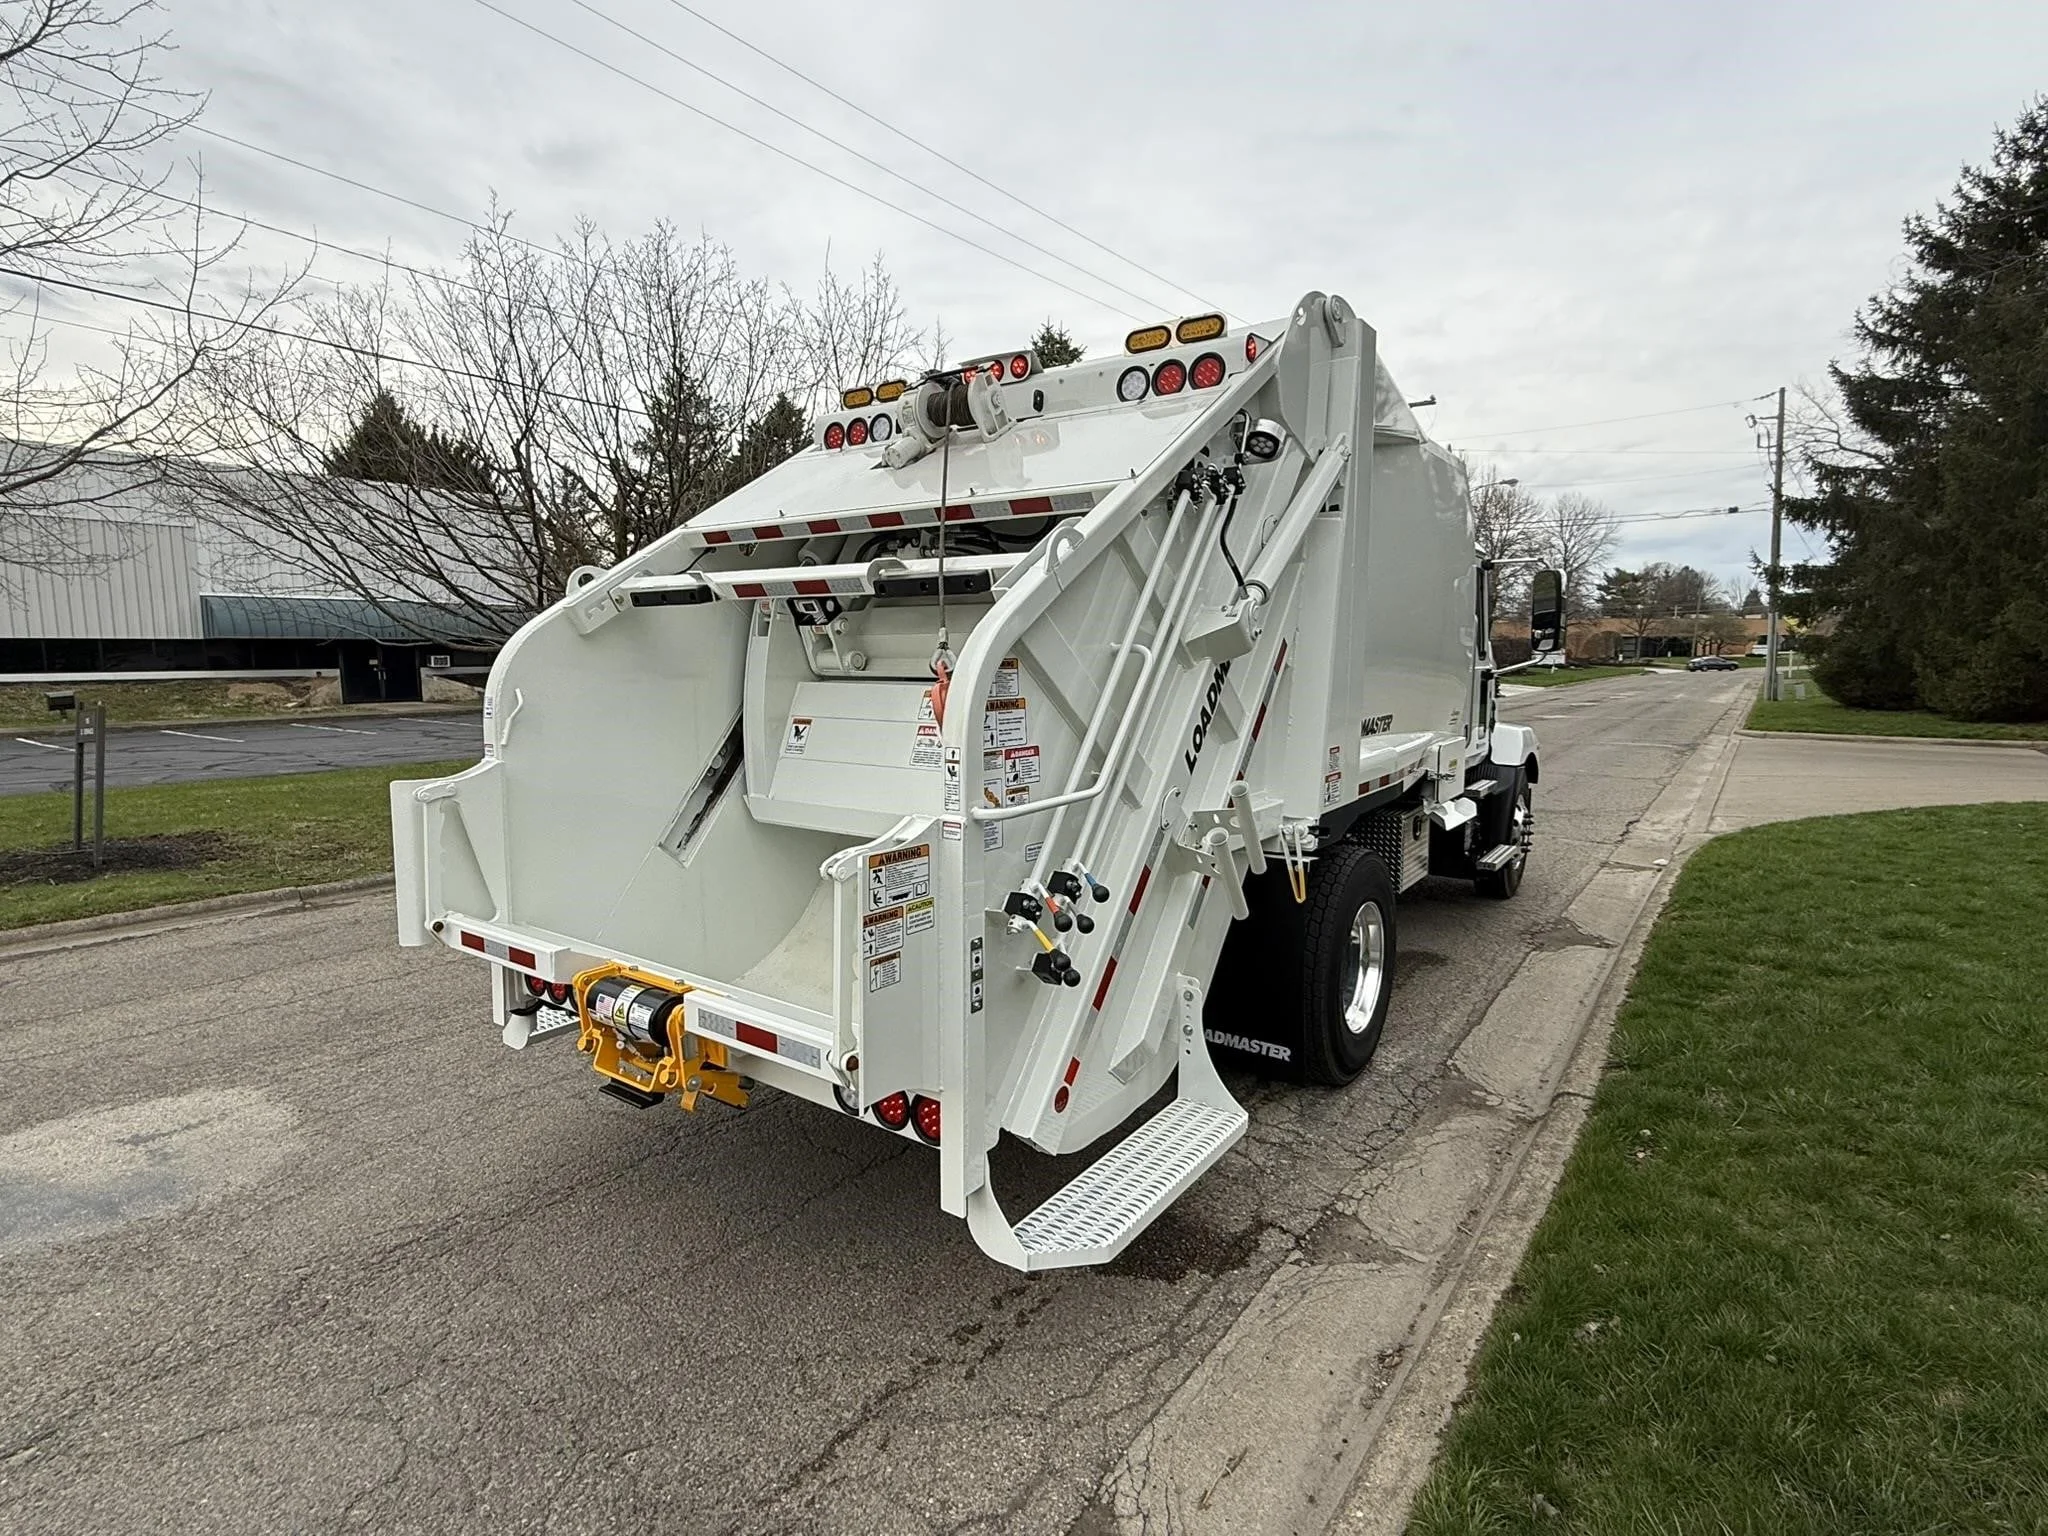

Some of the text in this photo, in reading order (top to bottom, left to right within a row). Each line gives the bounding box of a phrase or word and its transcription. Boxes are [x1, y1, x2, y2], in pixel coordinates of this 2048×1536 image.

[988, 701, 1020, 710] WARNING
[1361, 714, 1393, 736] MASTER
[885, 847, 922, 864] WARNING
[912, 900, 933, 911] CAUTION
[868, 909, 899, 925] WARNING
[1205, 1028, 1292, 1062] ADMASTER
